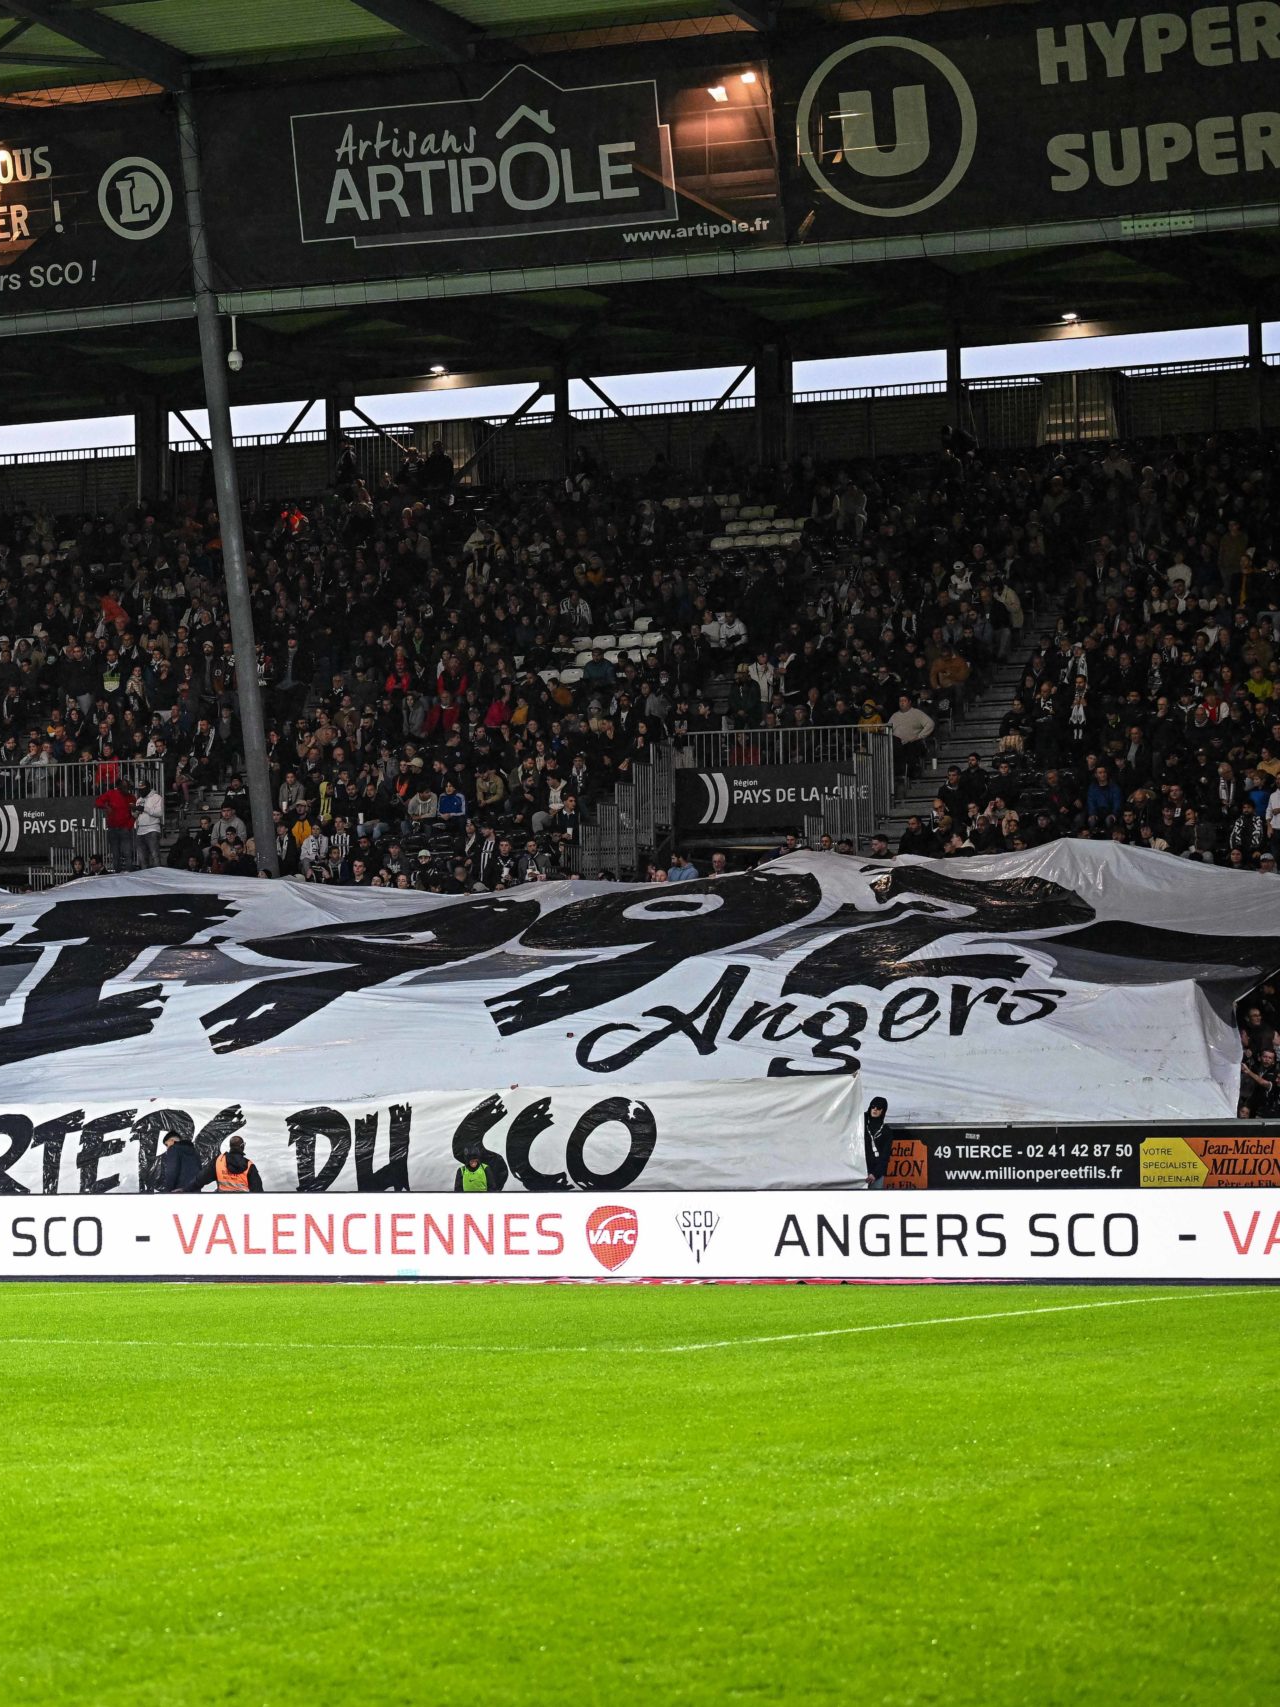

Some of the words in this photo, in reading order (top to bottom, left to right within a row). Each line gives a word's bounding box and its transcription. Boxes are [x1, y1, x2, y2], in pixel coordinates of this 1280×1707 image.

[1036, 1, 1280, 85] HYPER
[838, 84, 930, 177] U
[335, 121, 477, 163] Artisans
[1047, 111, 1280, 192] SUPER
[623, 217, 770, 244] www.artipole.fr
[29, 261, 83, 288] SCO
[733, 779, 758, 787] Région
[733, 789, 771, 804] PAYS
[776, 787, 796, 803] DE
[801, 786, 820, 801] LA
[23, 810, 45, 818] Région
[23, 820, 56, 834] PAYS
[575, 963, 1068, 1078] Angers
[285, 1101, 412, 1193] DU
[891, 1141, 915, 1157] chel
[934, 1145, 951, 1158] 49
[956, 1145, 1012, 1158] TIERCE
[1026, 1144, 1044, 1158] 02
[1048, 1144, 1065, 1158] 41
[1071, 1144, 1089, 1158] 42
[1093, 1144, 1111, 1157] 87
[1115, 1143, 1133, 1157] 50
[1200, 1139, 1274, 1157] Jean-Michel
[885, 1159, 925, 1177] LION
[945, 1165, 1123, 1182] www.millionpereetfils.fr
[1143, 1161, 1198, 1169] SPECIALISTE
[1158, 1175, 1200, 1183] PLEIN-AIR
[681, 1211, 713, 1229] SCO
[13, 1216, 103, 1257] SCO
[173, 1213, 564, 1257] VALENCIENNES
[588, 1228, 636, 1246] VAFC
[775, 1212, 1007, 1257] ANGERS
[1028, 1212, 1139, 1257] SCO
